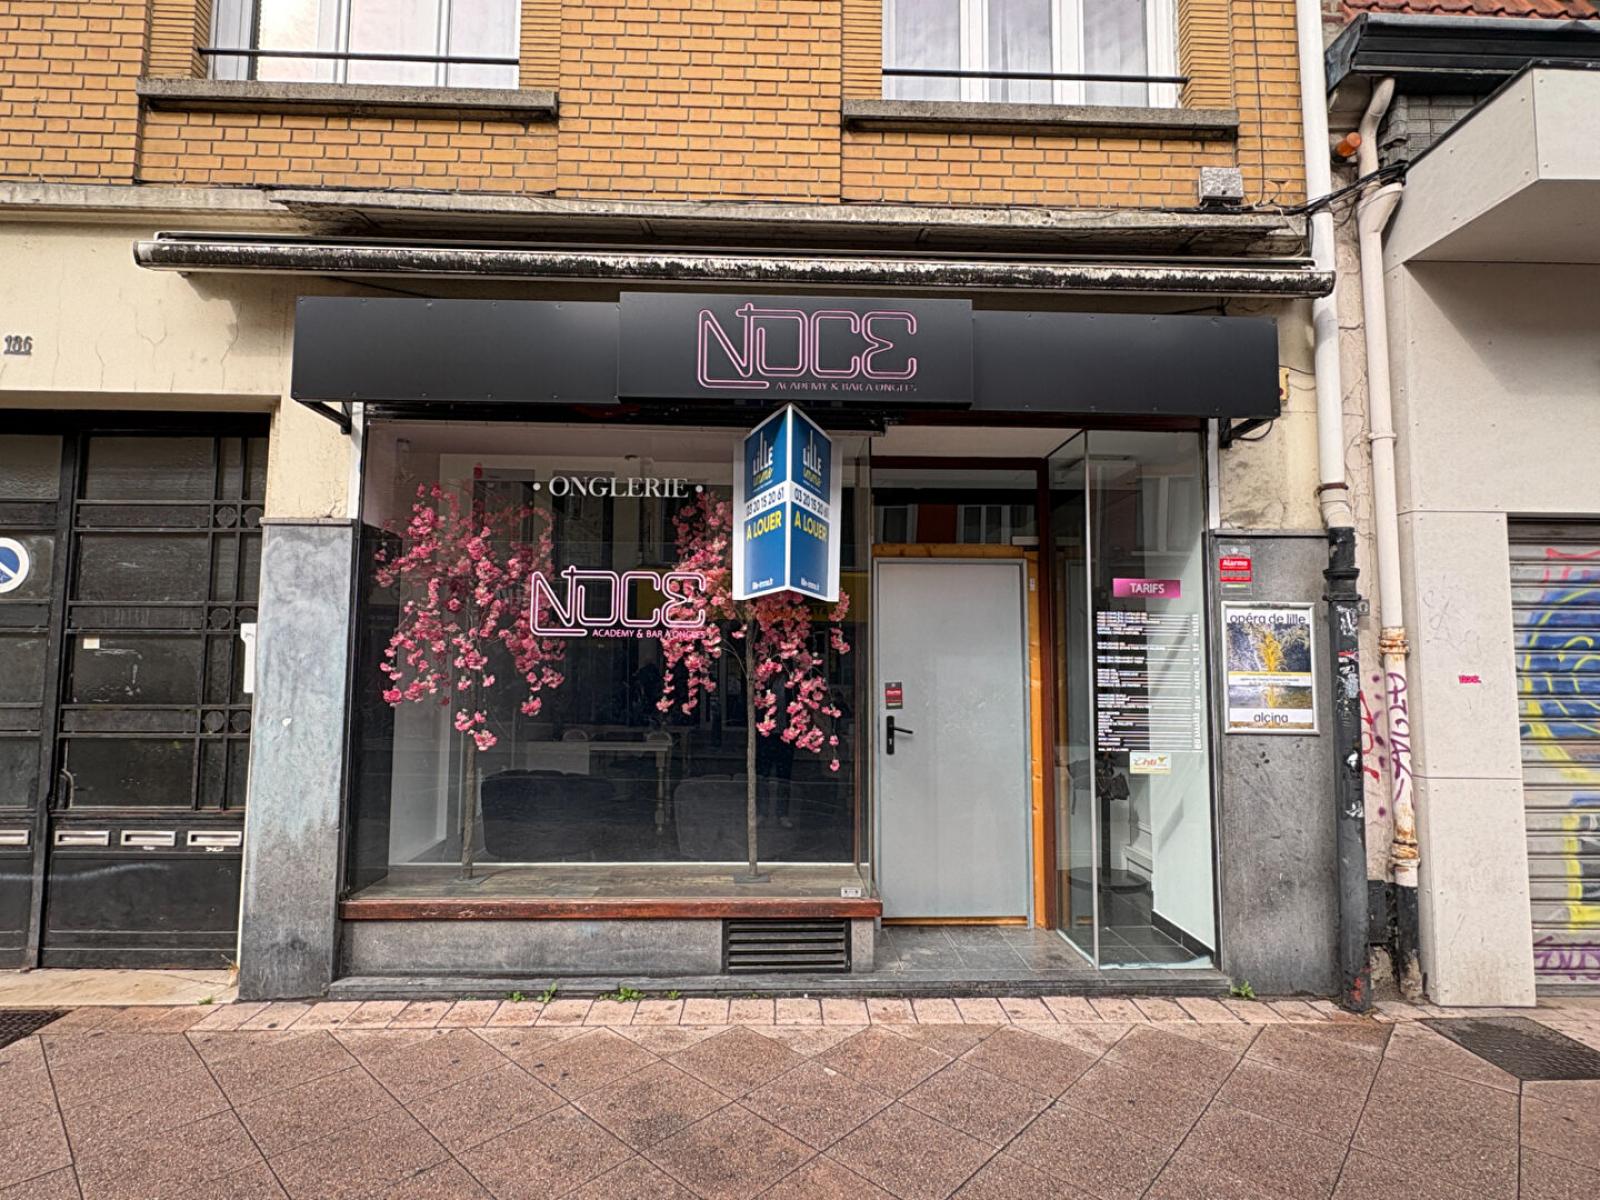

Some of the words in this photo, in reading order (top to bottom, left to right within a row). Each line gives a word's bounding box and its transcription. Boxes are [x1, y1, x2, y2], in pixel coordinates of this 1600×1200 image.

[549, 476, 689, 498] ONGLERIE
[753, 511, 782, 538] LOUER
[794, 511, 801, 528] A
[803, 515, 828, 540] LOUER
[1129, 582, 1165, 594] TARIFS
[1230, 612, 1266, 624] opéra
[1268, 613, 1284, 624] de
[1286, 613, 1306, 624] lille
[592, 629, 634, 638] ACADEMY
[636, 629, 643, 638] &
[646, 629, 662, 639] BAR
